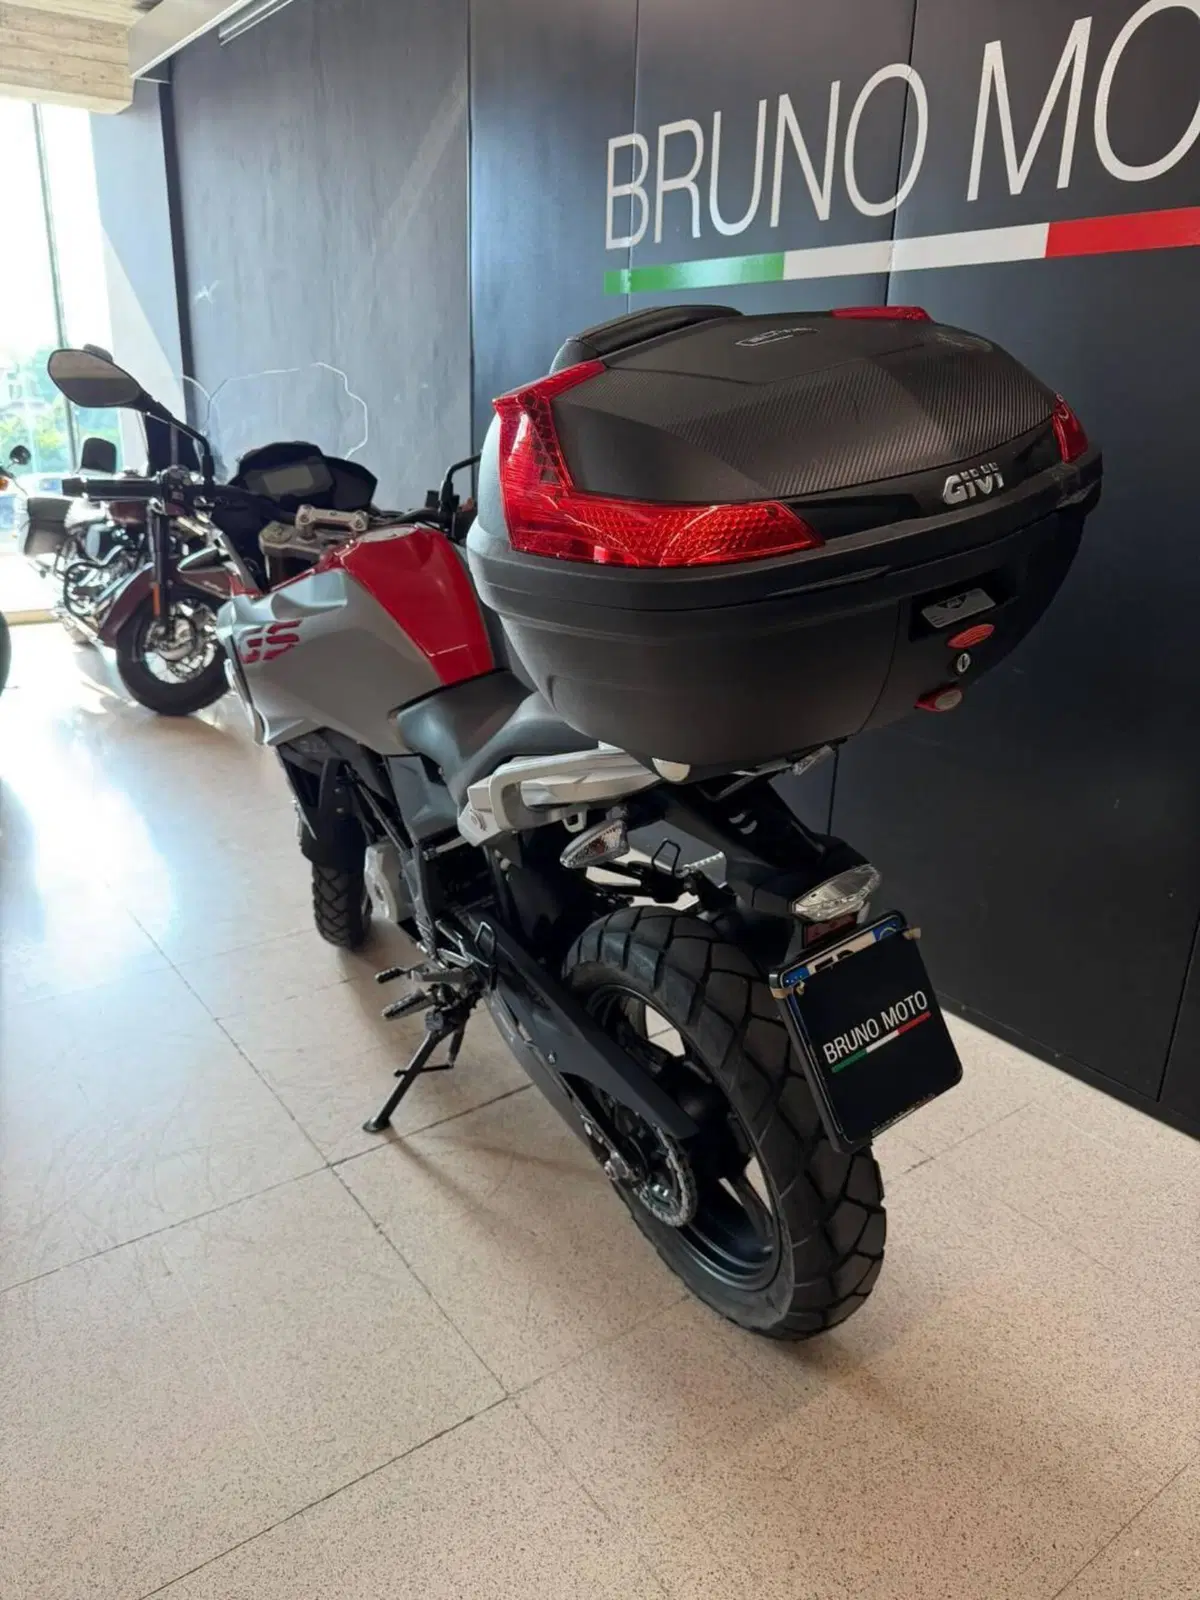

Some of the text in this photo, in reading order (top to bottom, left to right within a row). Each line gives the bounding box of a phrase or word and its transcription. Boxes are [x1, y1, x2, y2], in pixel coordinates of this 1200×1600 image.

[605, 0, 1200, 250] BRUNO MO
[942, 462, 1004, 504] GIVI
[822, 990, 928, 1064] BRUNO MOTO
